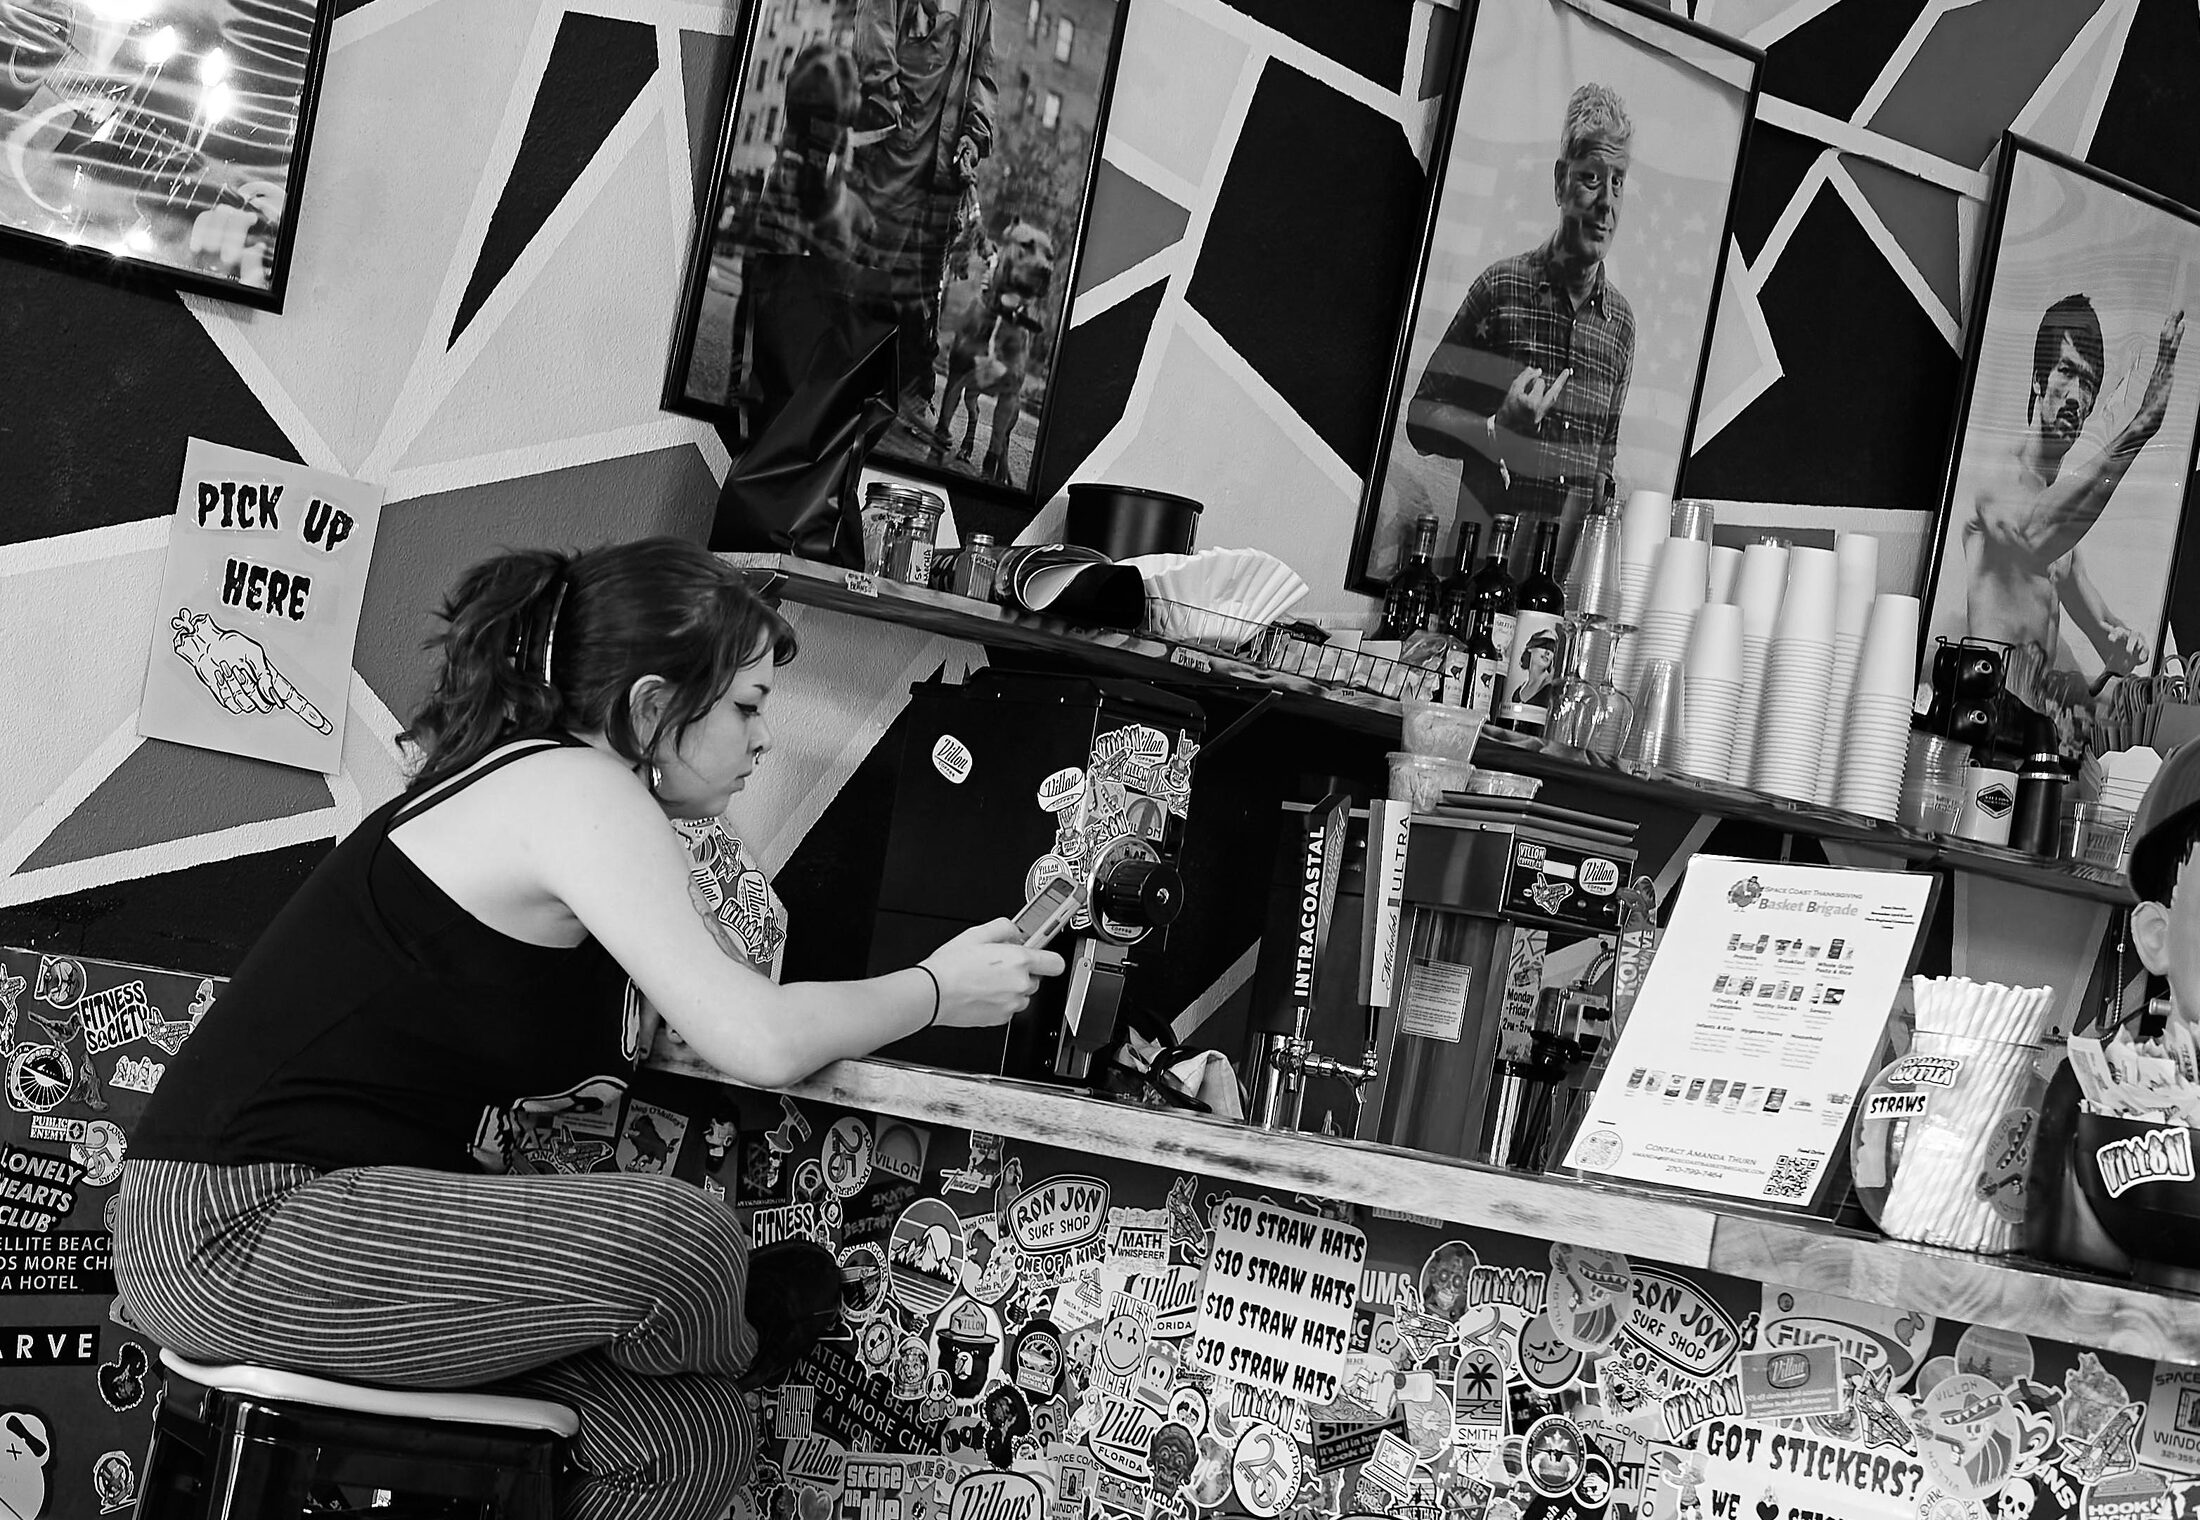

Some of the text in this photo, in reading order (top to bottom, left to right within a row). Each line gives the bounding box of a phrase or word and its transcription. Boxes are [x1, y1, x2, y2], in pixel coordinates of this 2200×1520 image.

[198, 482, 354, 551] PICK UP
[221, 558, 310, 621] HERE
[942, 738, 969, 770] Villon
[1141, 731, 1164, 752] illon
[1045, 771, 1078, 797] Villon
[1392, 815, 1411, 897] ULTRA
[1520, 845, 1546, 860] VILLON
[1583, 861, 1615, 881] Villon
[1294, 826, 1325, 997] INTRACOASTAL
[1758, 898, 1858, 917] Basket Brigade
[1382, 912, 1399, 991] Michelob
[1617, 931, 1641, 996] KONA
[81, 983, 145, 1030] FITNESS
[1507, 989, 1535, 1006] Monday
[86, 1004, 150, 1051] SOCIETY
[1869, 1095, 1926, 1114] STRAWS
[30, 1127, 67, 1141] ENEMY
[32, 1115, 68, 1128] PUBLIC
[106, 1123, 127, 1146] LONG
[875, 1152, 922, 1181] VILLON
[1645, 1143, 1686, 1155] CONTACT
[1687, 1149, 1725, 1162] AMANDA
[2100, 1132, 2189, 1191] VILLON
[0, 1152, 82, 1185] LONELY
[1017, 1186, 1102, 1231] RON JON
[754, 1204, 814, 1248] FITNESS
[1028, 1215, 1090, 1241] SURF SHOP
[1122, 1232, 1163, 1250] MATH
[1223, 1203, 1365, 1263] $10 STRAW HATS
[25, 1256, 76, 1270] MORE
[1015, 1239, 1107, 1273] ONE OF A KIND
[1118, 1248, 1165, 1260] WHISPERER
[1, 1275, 78, 1289] A HOTEL
[1214, 1247, 1355, 1309] $10 STRAW HATS
[1470, 1268, 1544, 1315] VILLON
[1153, 1321, 1192, 1331] ORIDA
[1206, 1292, 1234, 1321] $10
[1238, 1301, 1298, 1340] STRAW
[1301, 1319, 1346, 1355] HATS
[1633, 1279, 1731, 1352] RON JON
[0, 1334, 92, 1359] RVE
[1632, 1310, 1706, 1361] SURF SHOP
[811, 1344, 882, 1397] ATELLITE
[1196, 1337, 1336, 1400] $10 STRAW HATS
[1633, 1353, 1658, 1375] OF
[1772, 1357, 1805, 1382] Villon
[795, 1359, 896, 1437] NEEDS MORE
[1935, 1380, 1978, 1401] VILLON
[823, 1406, 833, 1423] A
[1231, 1382, 1296, 1434] VILLON
[1664, 1375, 1743, 1439] VILLON
[1458, 1429, 1498, 1441] SMITH
[788, 1438, 844, 1477] Villon
[1098, 1446, 1143, 1473] FLORIDA
[1707, 1421, 1924, 1502] GOT STICKERS?
[1144, 1485, 1185, 1514] VILLON
[1712, 1489, 1741, 1520] WE
